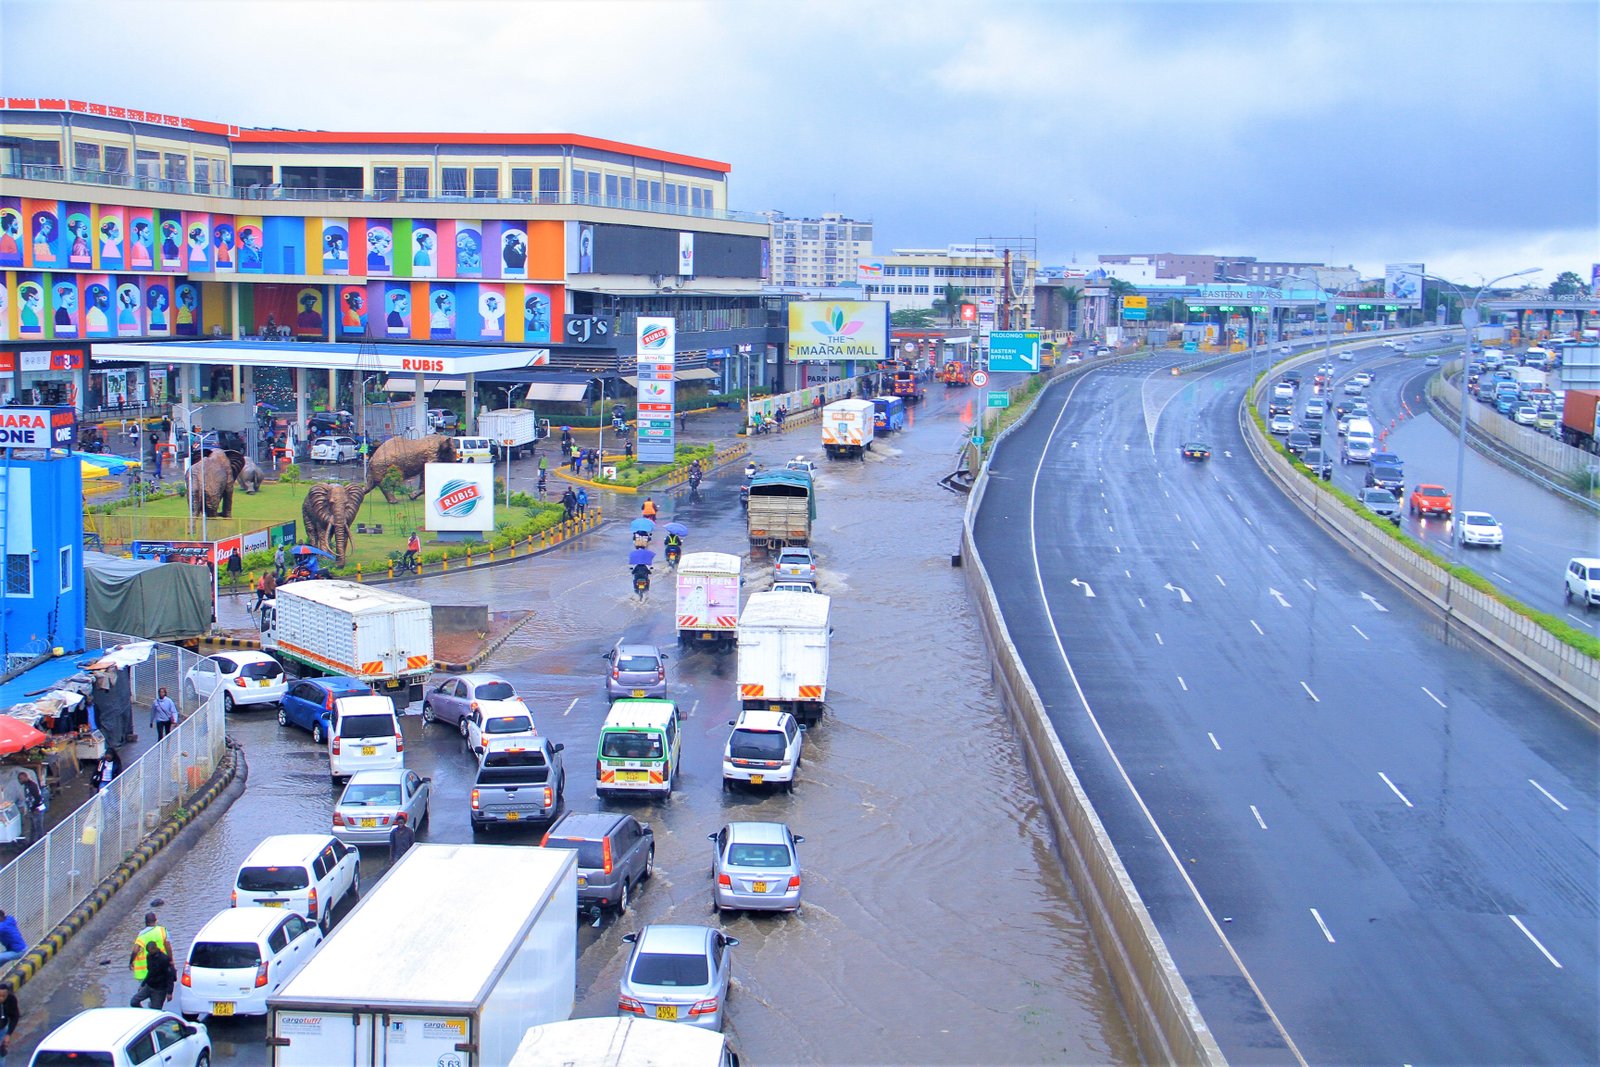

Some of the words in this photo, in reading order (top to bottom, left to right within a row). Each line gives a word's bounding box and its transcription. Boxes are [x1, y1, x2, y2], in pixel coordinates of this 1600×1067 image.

[1202, 290, 1242, 298] EASTERN
[797, 346, 843, 355] IMAARA
[847, 346, 878, 355] MALL
[402, 358, 444, 372] RUBiS
[975, 375, 985, 383] 40
[0, 429, 35, 444] ONE
[55, 427, 72, 442] ONE
[245, 540, 267, 553] Hotpoint
